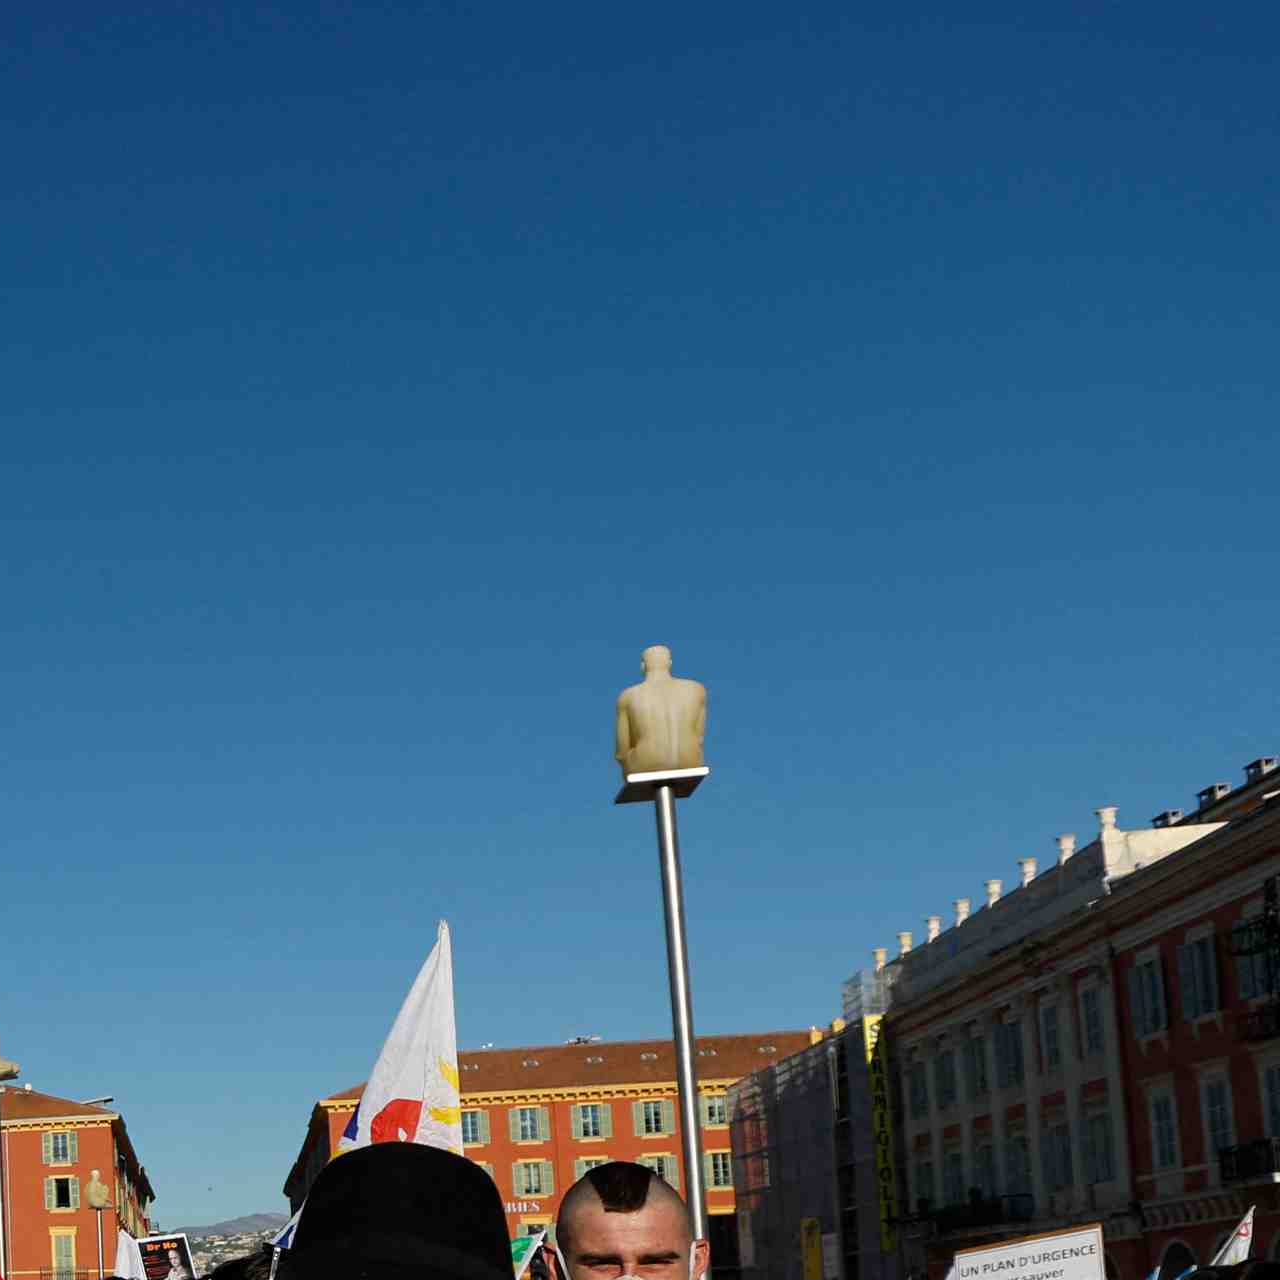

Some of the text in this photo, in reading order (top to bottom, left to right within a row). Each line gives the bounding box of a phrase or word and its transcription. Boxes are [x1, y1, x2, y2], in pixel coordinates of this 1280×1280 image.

[960, 1243, 1097, 1278] UN PLAN D'URGENCE
